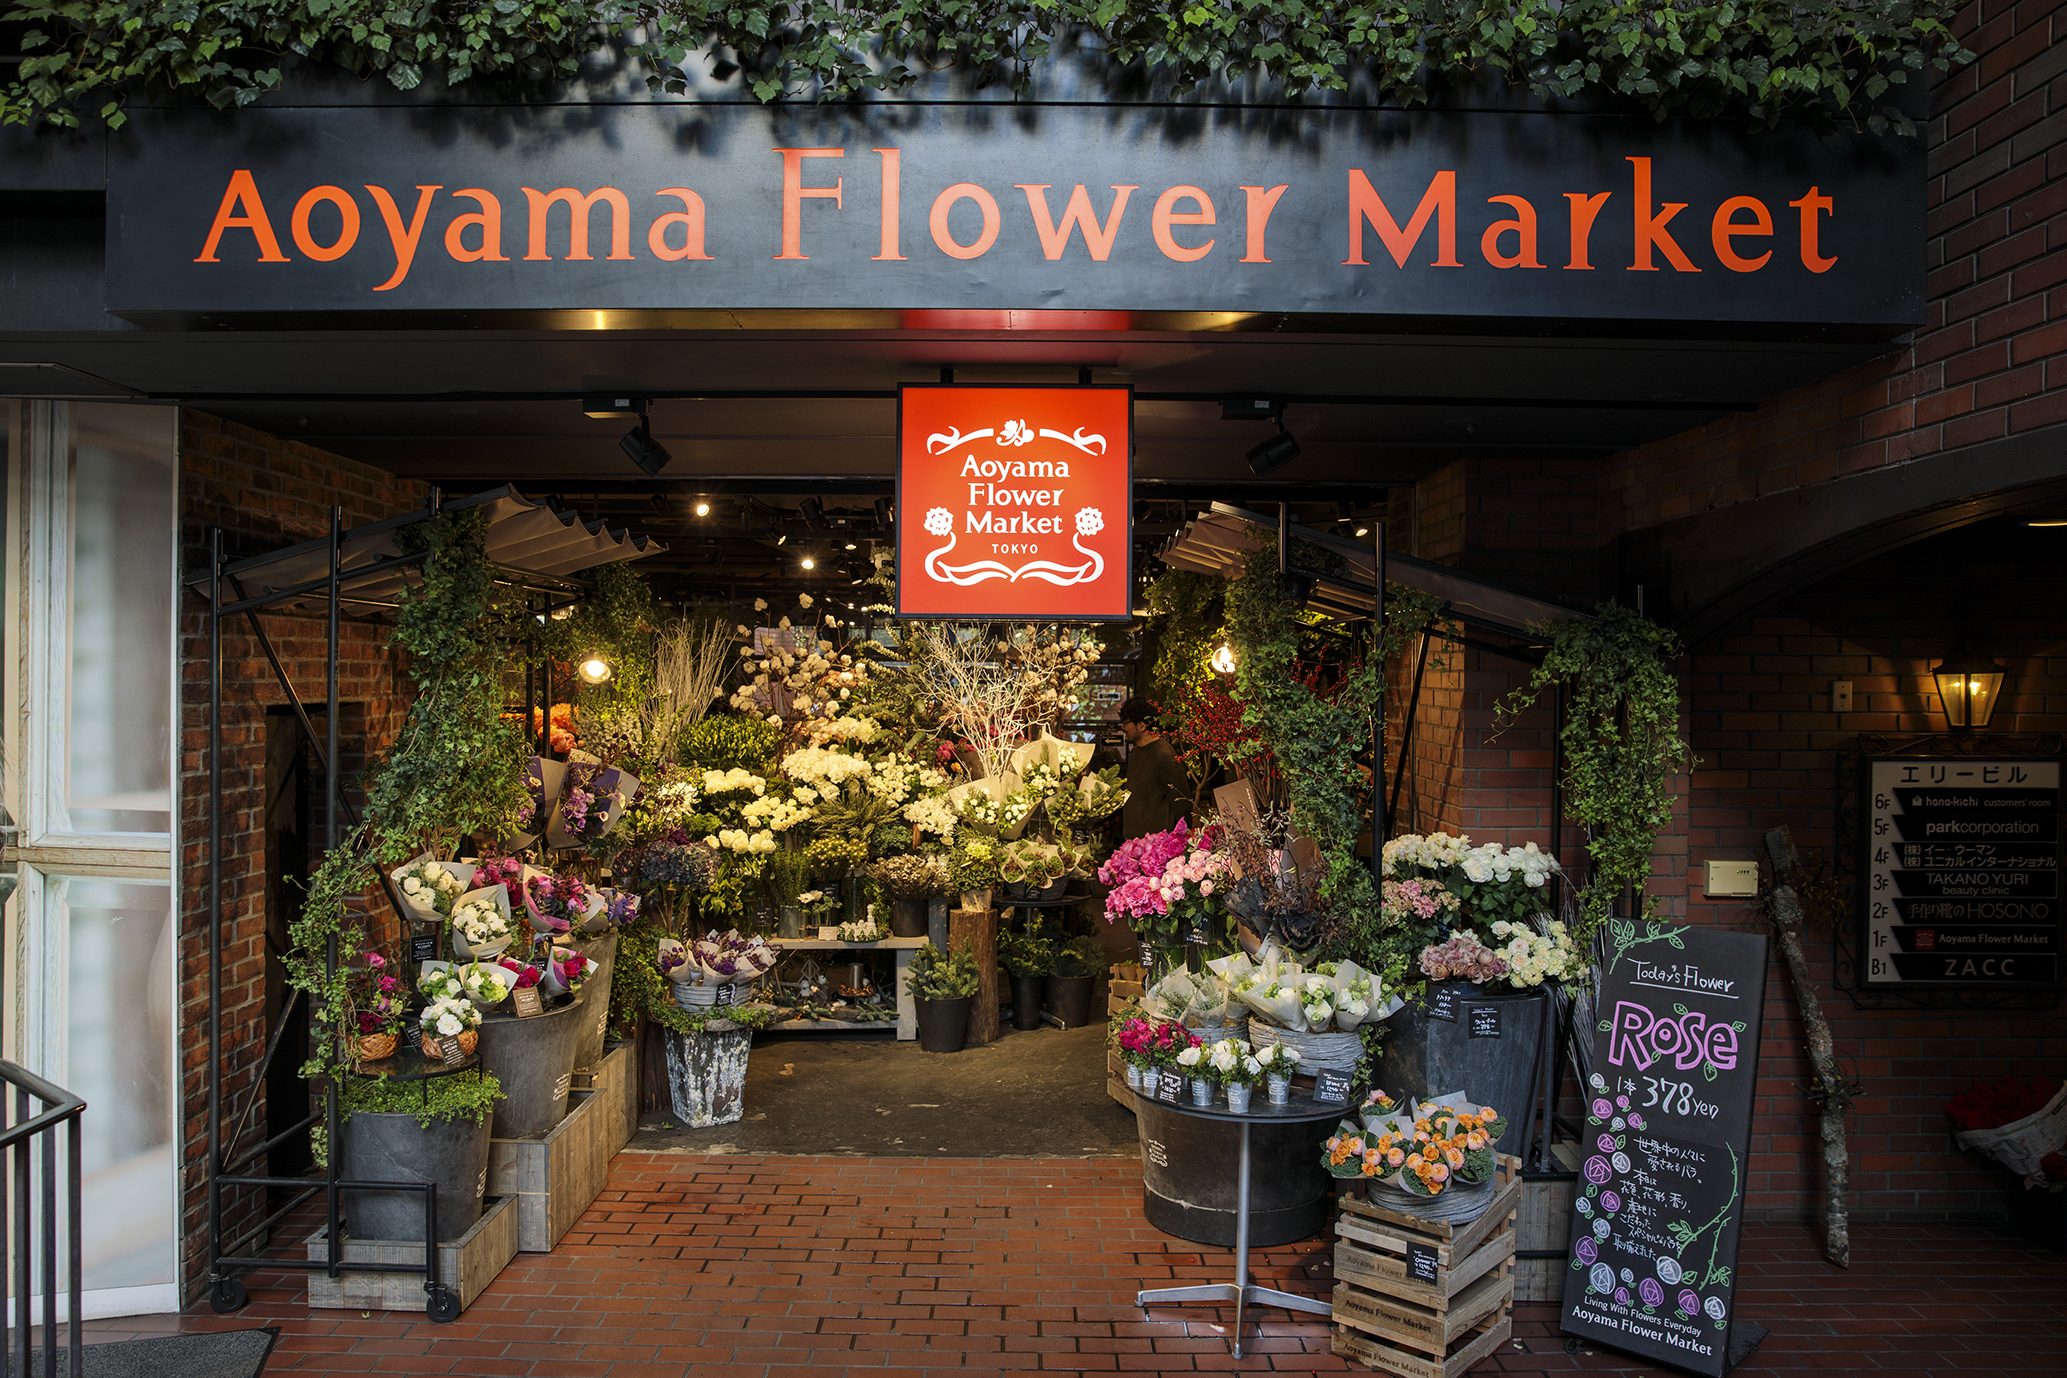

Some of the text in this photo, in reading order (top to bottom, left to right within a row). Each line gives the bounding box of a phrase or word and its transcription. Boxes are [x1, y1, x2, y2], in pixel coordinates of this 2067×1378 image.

[193, 148, 1838, 291] Aoyama Flower Market
[960, 454, 1071, 483] Aoyama
[968, 483, 1065, 506] Flower
[965, 511, 1063, 534] Market
[991, 544, 1038, 554] TOKYO
[1900, 765, 2028, 784] エリービル
[1875, 794, 1891, 810] 6F
[1925, 797, 1978, 807] hana-kichi
[2029, 799, 2051, 807] room
[1874, 818, 2039, 836] 5F parkcorporation
[1874, 847, 1890, 864] 4F
[1873, 873, 2029, 890] 3F TAKANO YURI
[1942, 885, 2010, 896] beauty clinic
[1873, 903, 1888, 919] 2F
[1872, 930, 1887, 947] 1F
[1939, 934, 1976, 944] Aoyama
[1978, 934, 2011, 944] Flower
[2013, 934, 2049, 944] Market
[1627, 957, 1735, 992] Today's Flower
[1871, 958, 2014, 976] B1 ZACC
[1346, 1255, 1375, 1270] Aoyama
[1376, 1264, 1403, 1277] Flower
[1345, 1299, 1432, 1333] Aoyama Flower Market
[1584, 1296, 1702, 1338] Living With Flowers Everyday
[1572, 1305, 1713, 1356] Aoyama Flower Market
[1344, 1343, 1429, 1378] Aoyama Flower Market
